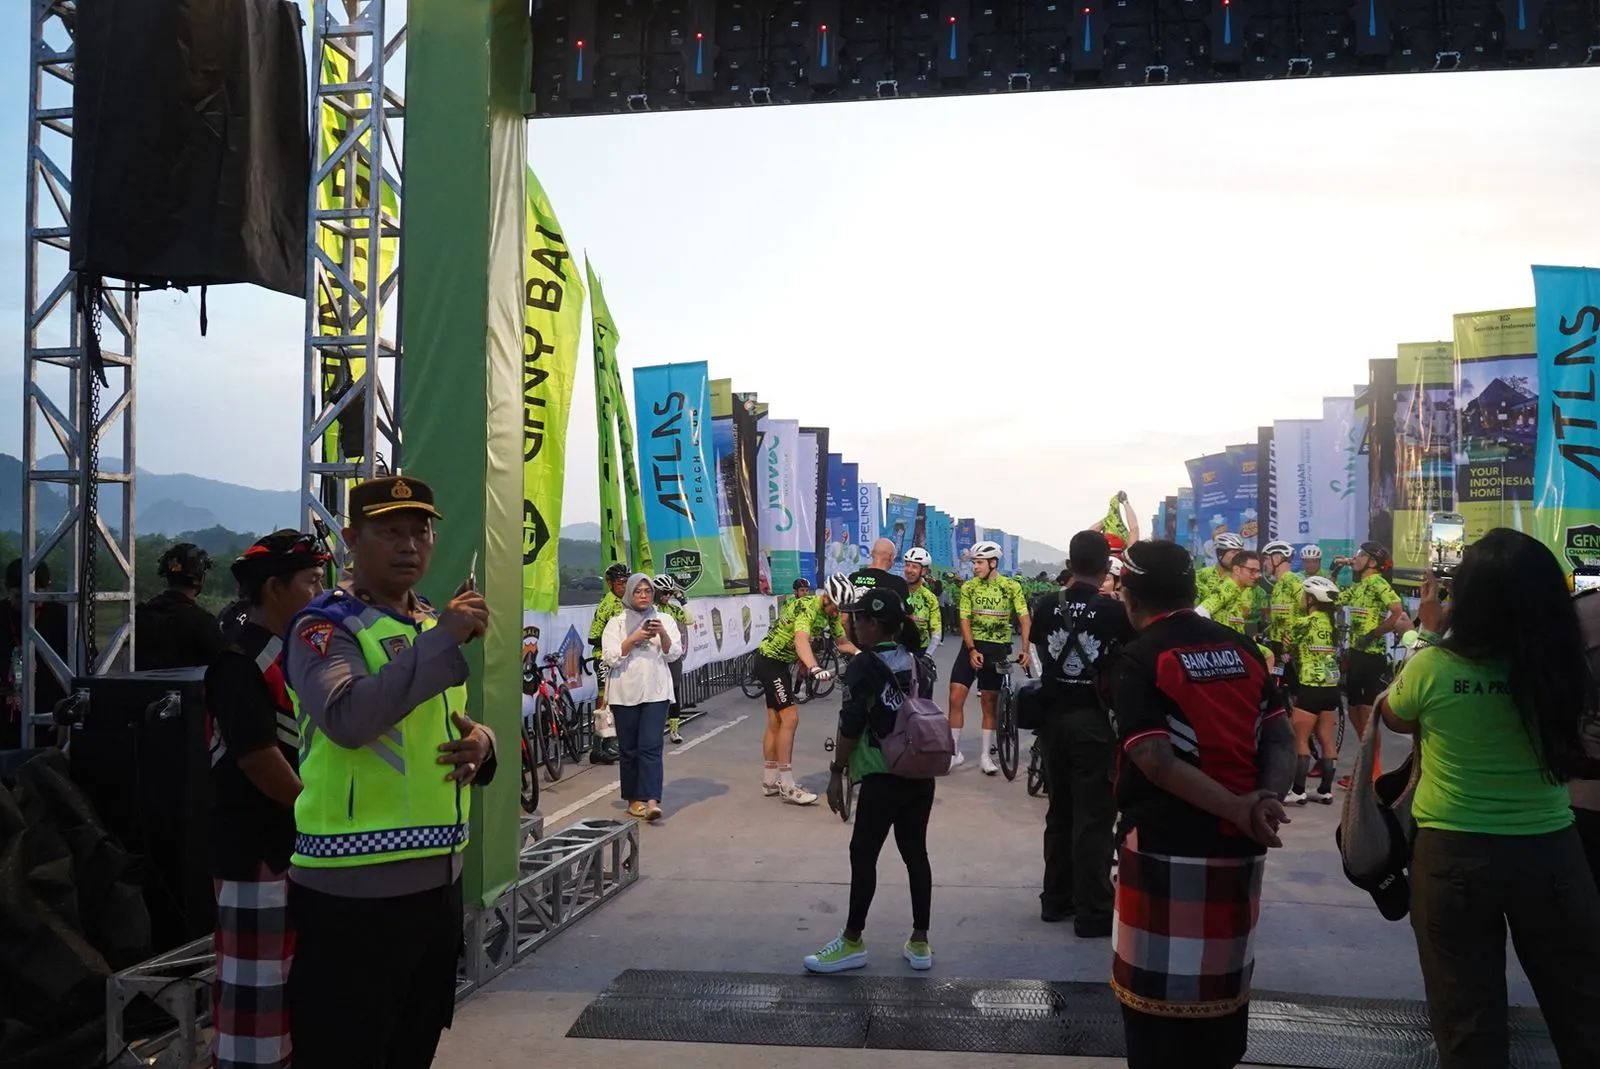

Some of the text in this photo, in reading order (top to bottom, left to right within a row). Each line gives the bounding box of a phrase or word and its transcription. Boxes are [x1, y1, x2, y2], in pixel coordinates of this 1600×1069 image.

[694, 454, 703, 504] BEACH
[1469, 467, 1499, 477] YOUR
[1297, 463, 1308, 519] WYNDHAM
[1470, 487, 1502, 498] HOME
[860, 486, 870, 543] PELINDO
[1572, 534, 1600, 548] GFN
[670, 556, 696, 567] GFNY
[975, 596, 1001, 606] GFNY
[773, 677, 788, 704] TriVelo
[1454, 680, 1470, 694] BE
[1473, 680, 1484, 694] A
